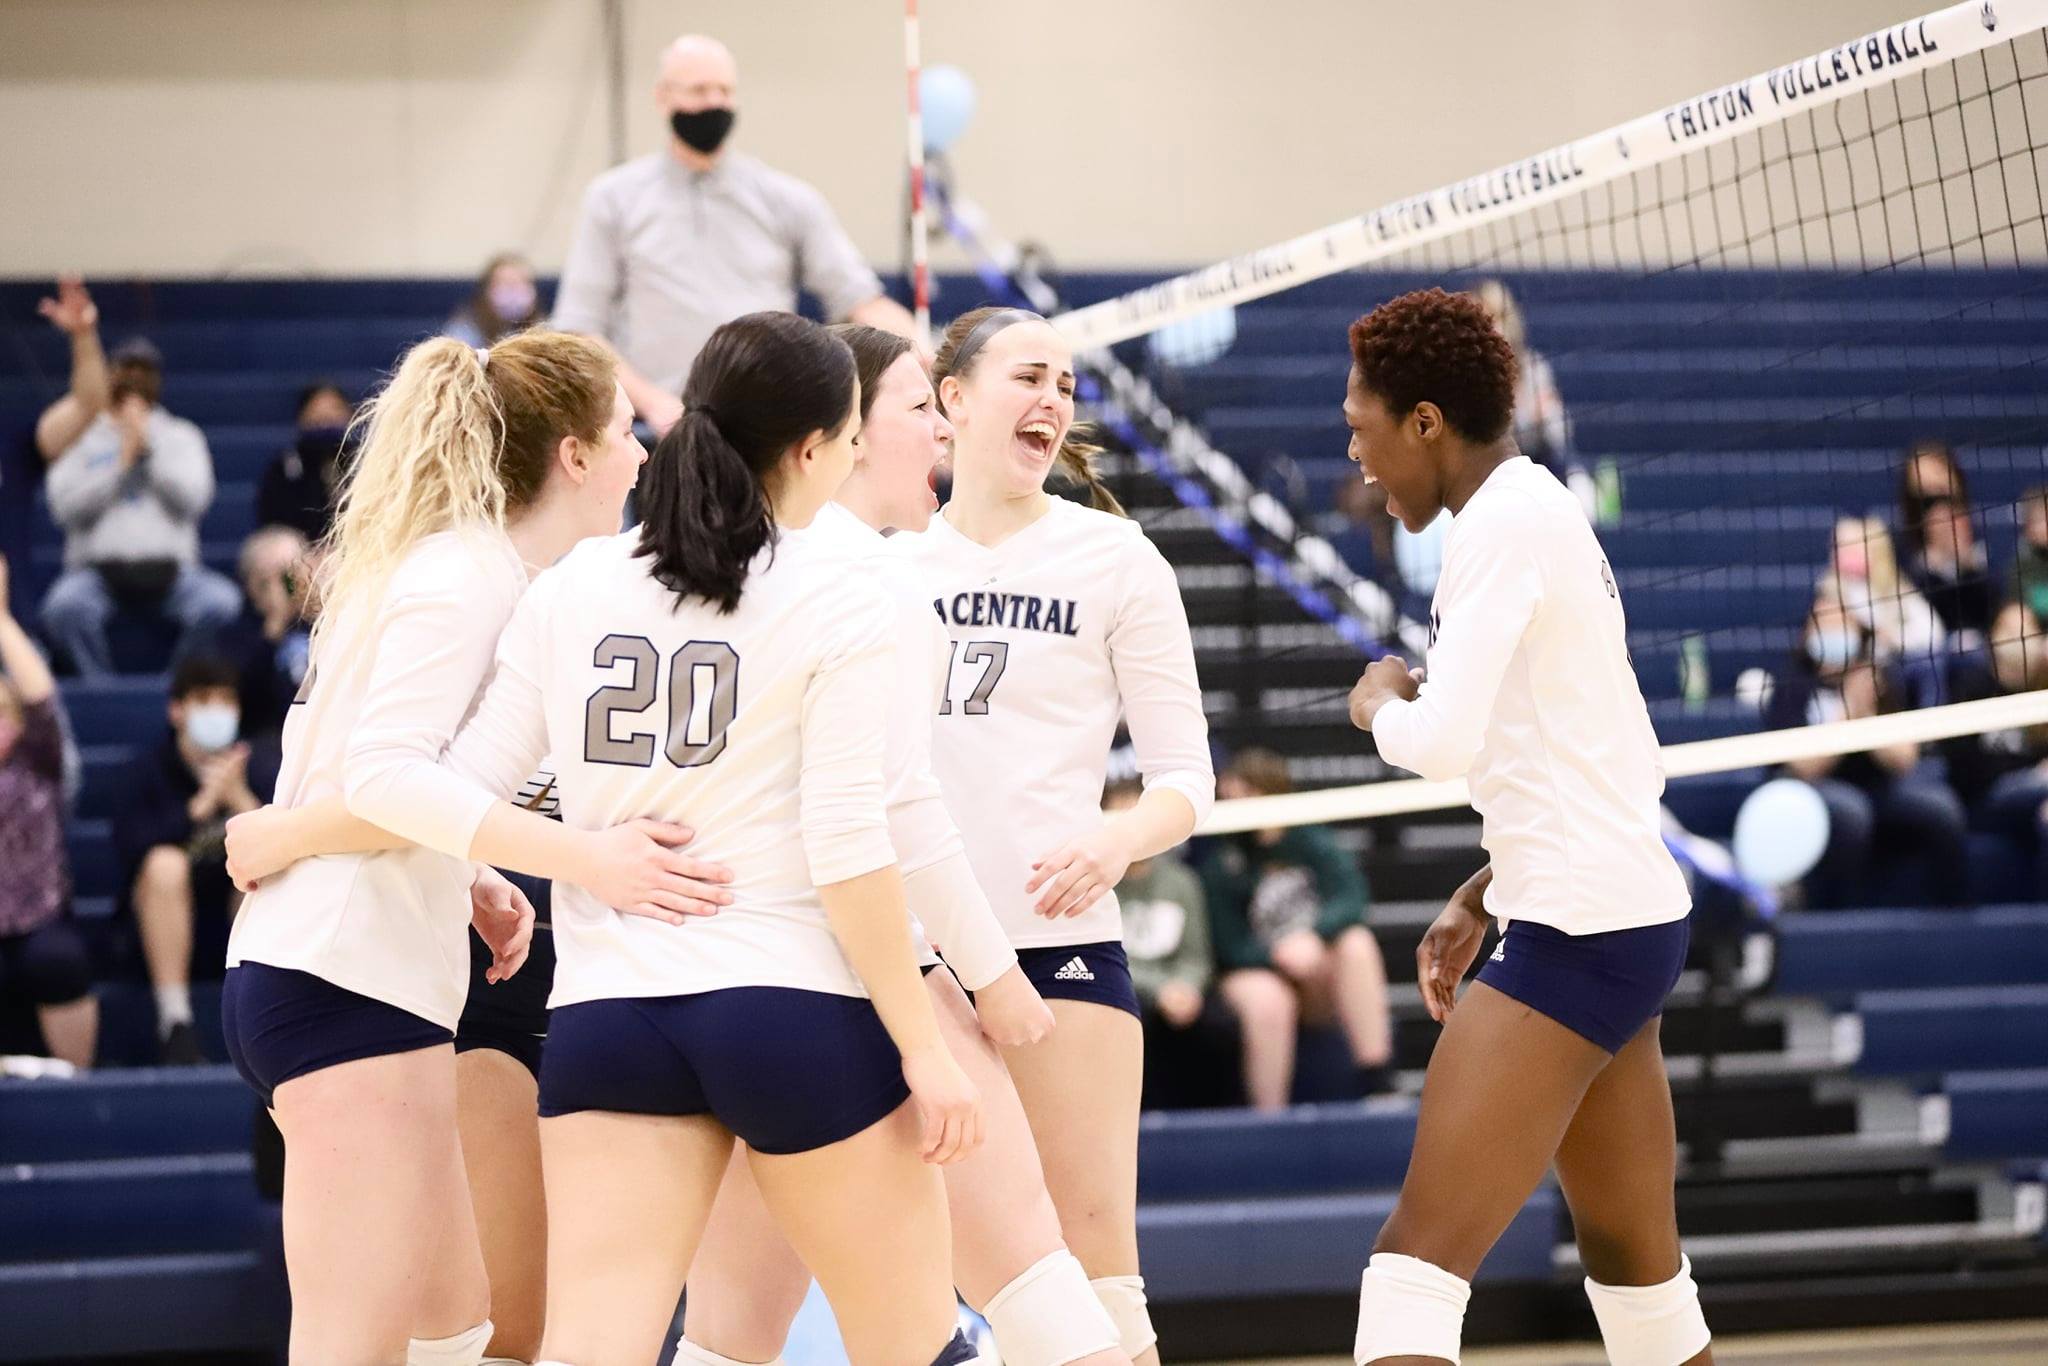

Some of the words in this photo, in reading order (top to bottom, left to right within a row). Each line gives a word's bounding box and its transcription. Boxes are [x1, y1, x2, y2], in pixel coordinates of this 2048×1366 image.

[1663, 86, 1754, 142] TRITON
[1767, 19, 1938, 104] VOLLEYBALL
[1450, 143, 1583, 216] VOLLEYBALL
[952, 592, 1081, 637] CENTRAL
[584, 633, 740, 768] 20
[1054, 969, 1095, 981] adidas
